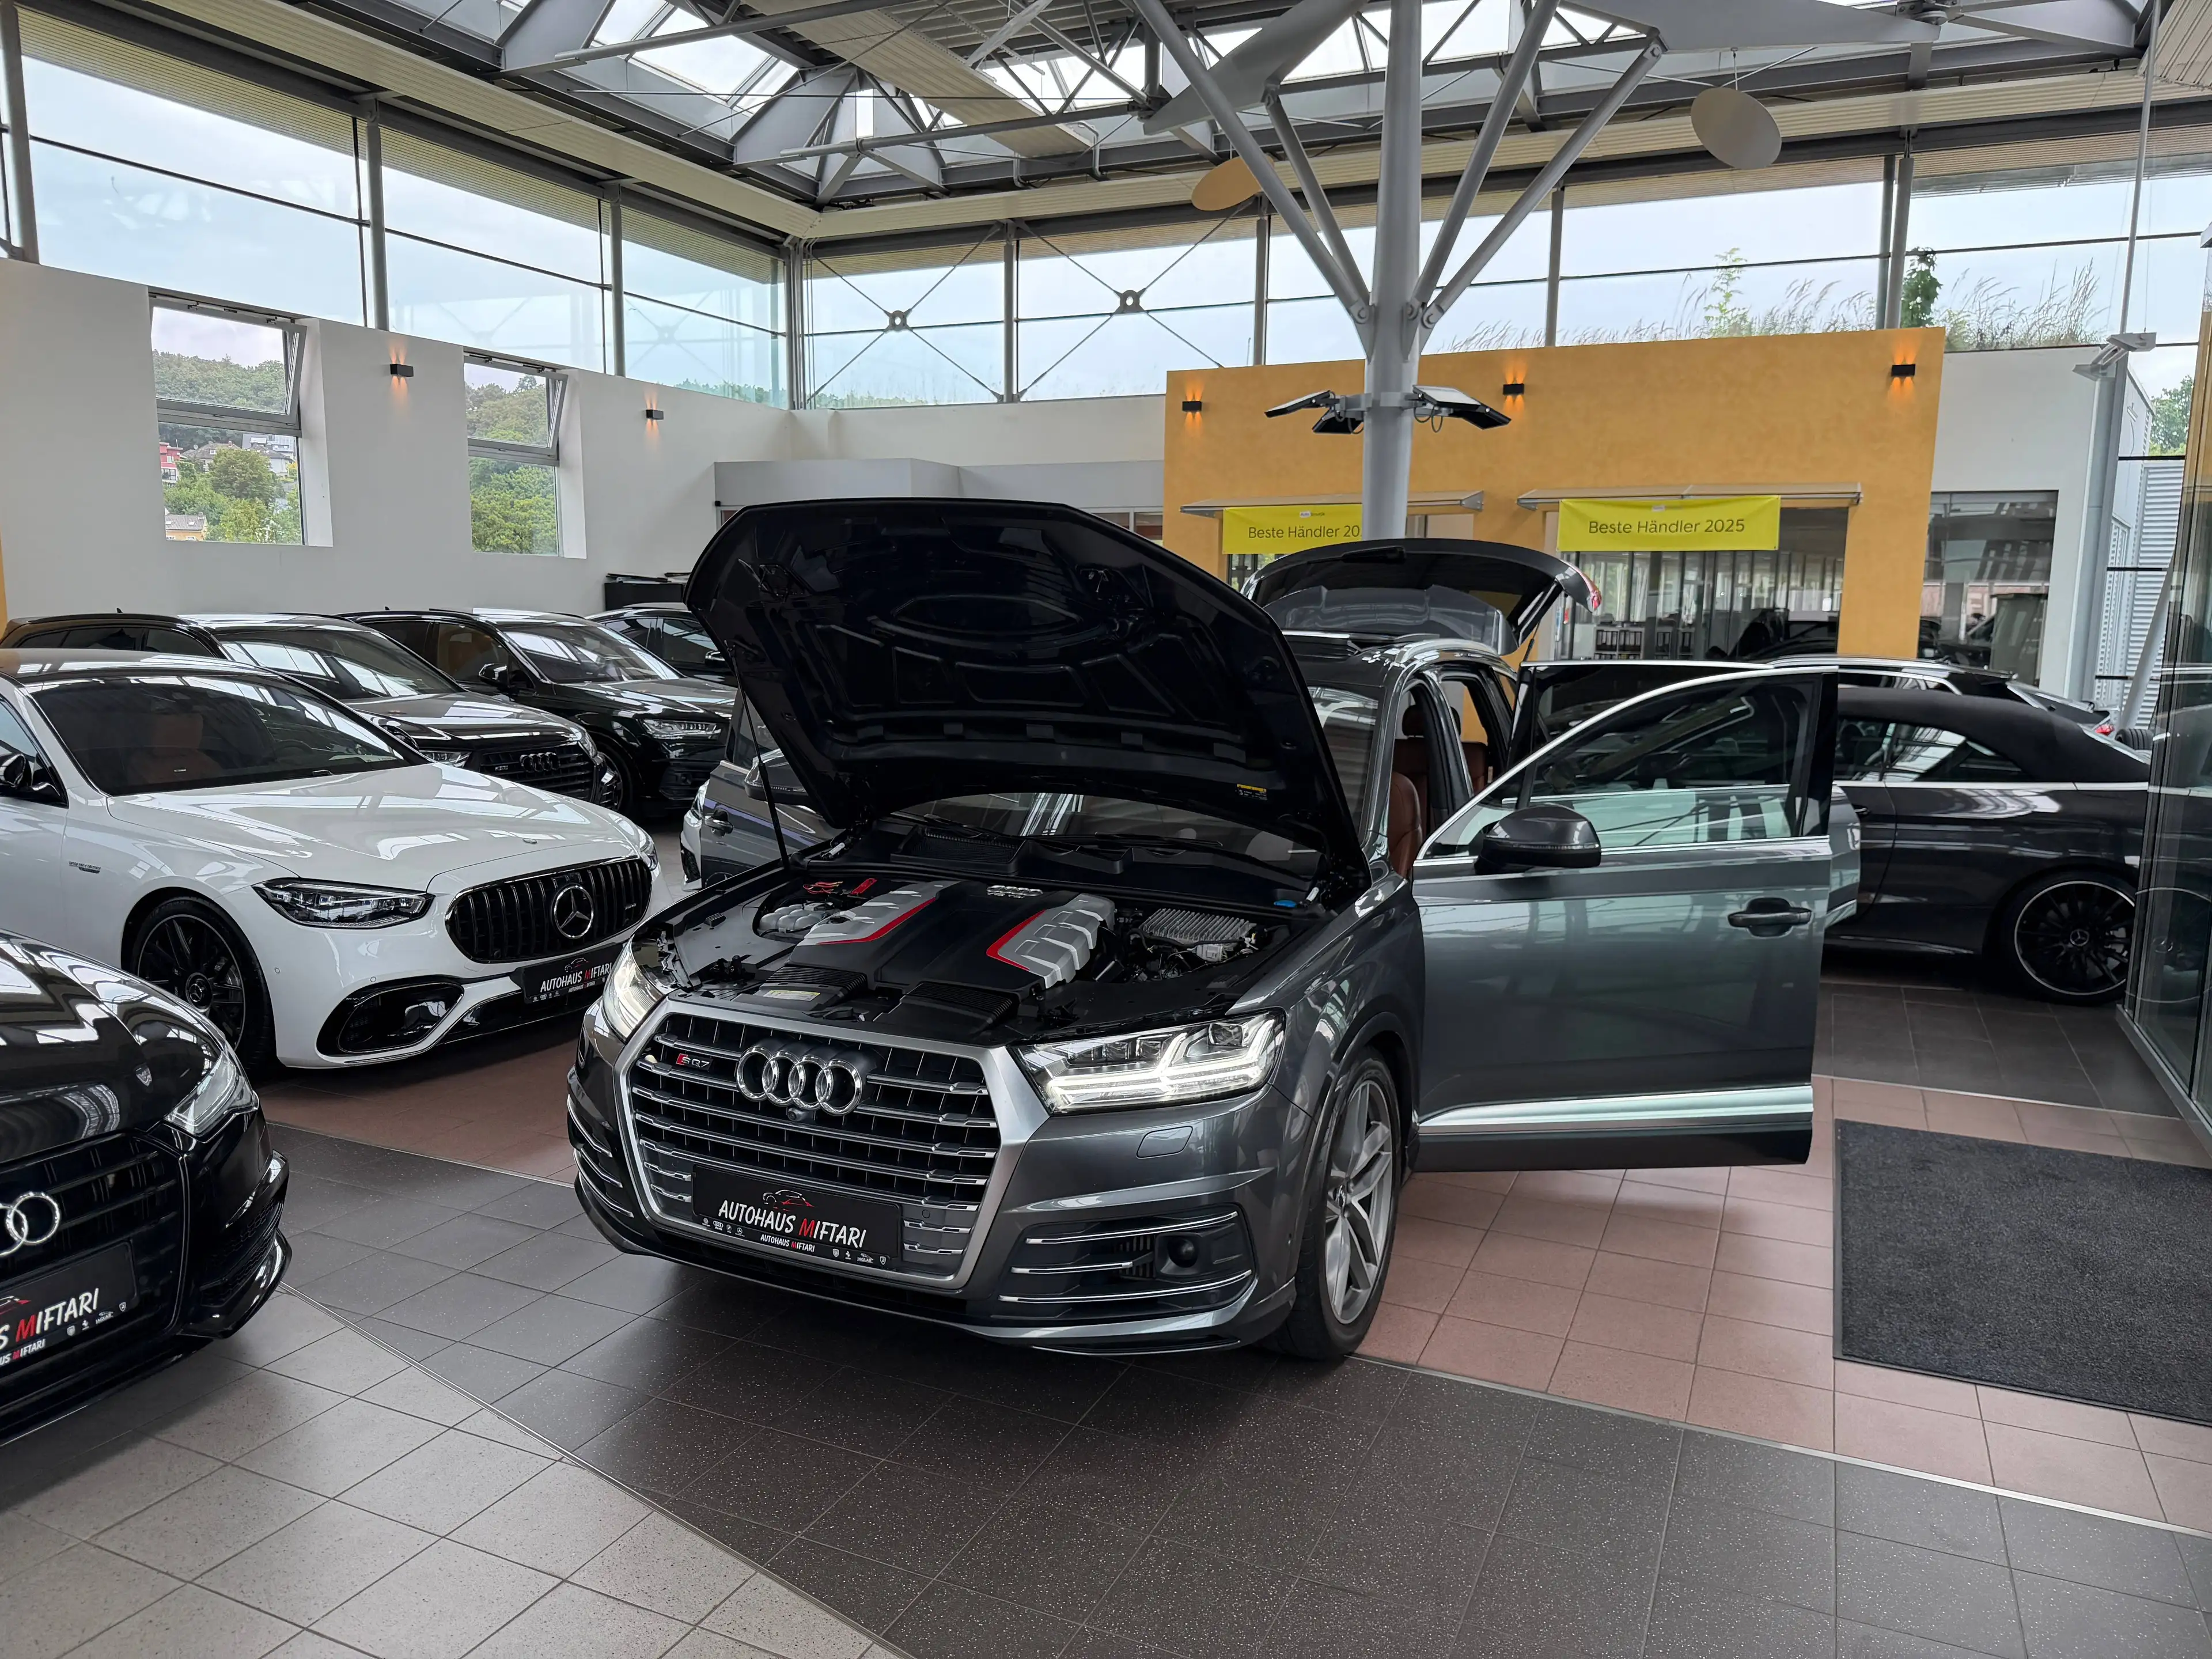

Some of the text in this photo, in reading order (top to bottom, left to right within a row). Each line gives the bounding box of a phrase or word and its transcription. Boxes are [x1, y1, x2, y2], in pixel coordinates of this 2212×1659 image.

[1248, 525, 1362, 539] Beste Händler 20
[1589, 518, 1745, 534] Beste Händler 2025
[540, 971, 583, 993] AUTOHAUS
[679, 1055, 710, 1067] SQ7
[718, 1200, 867, 1248] AUTOHAUS MIFTARI
[760, 1234, 815, 1252] AUTOHAUS MIFTARI
[16, 1287, 99, 1342] MIFTARI
[12, 1338, 46, 1360] MIFTARI
